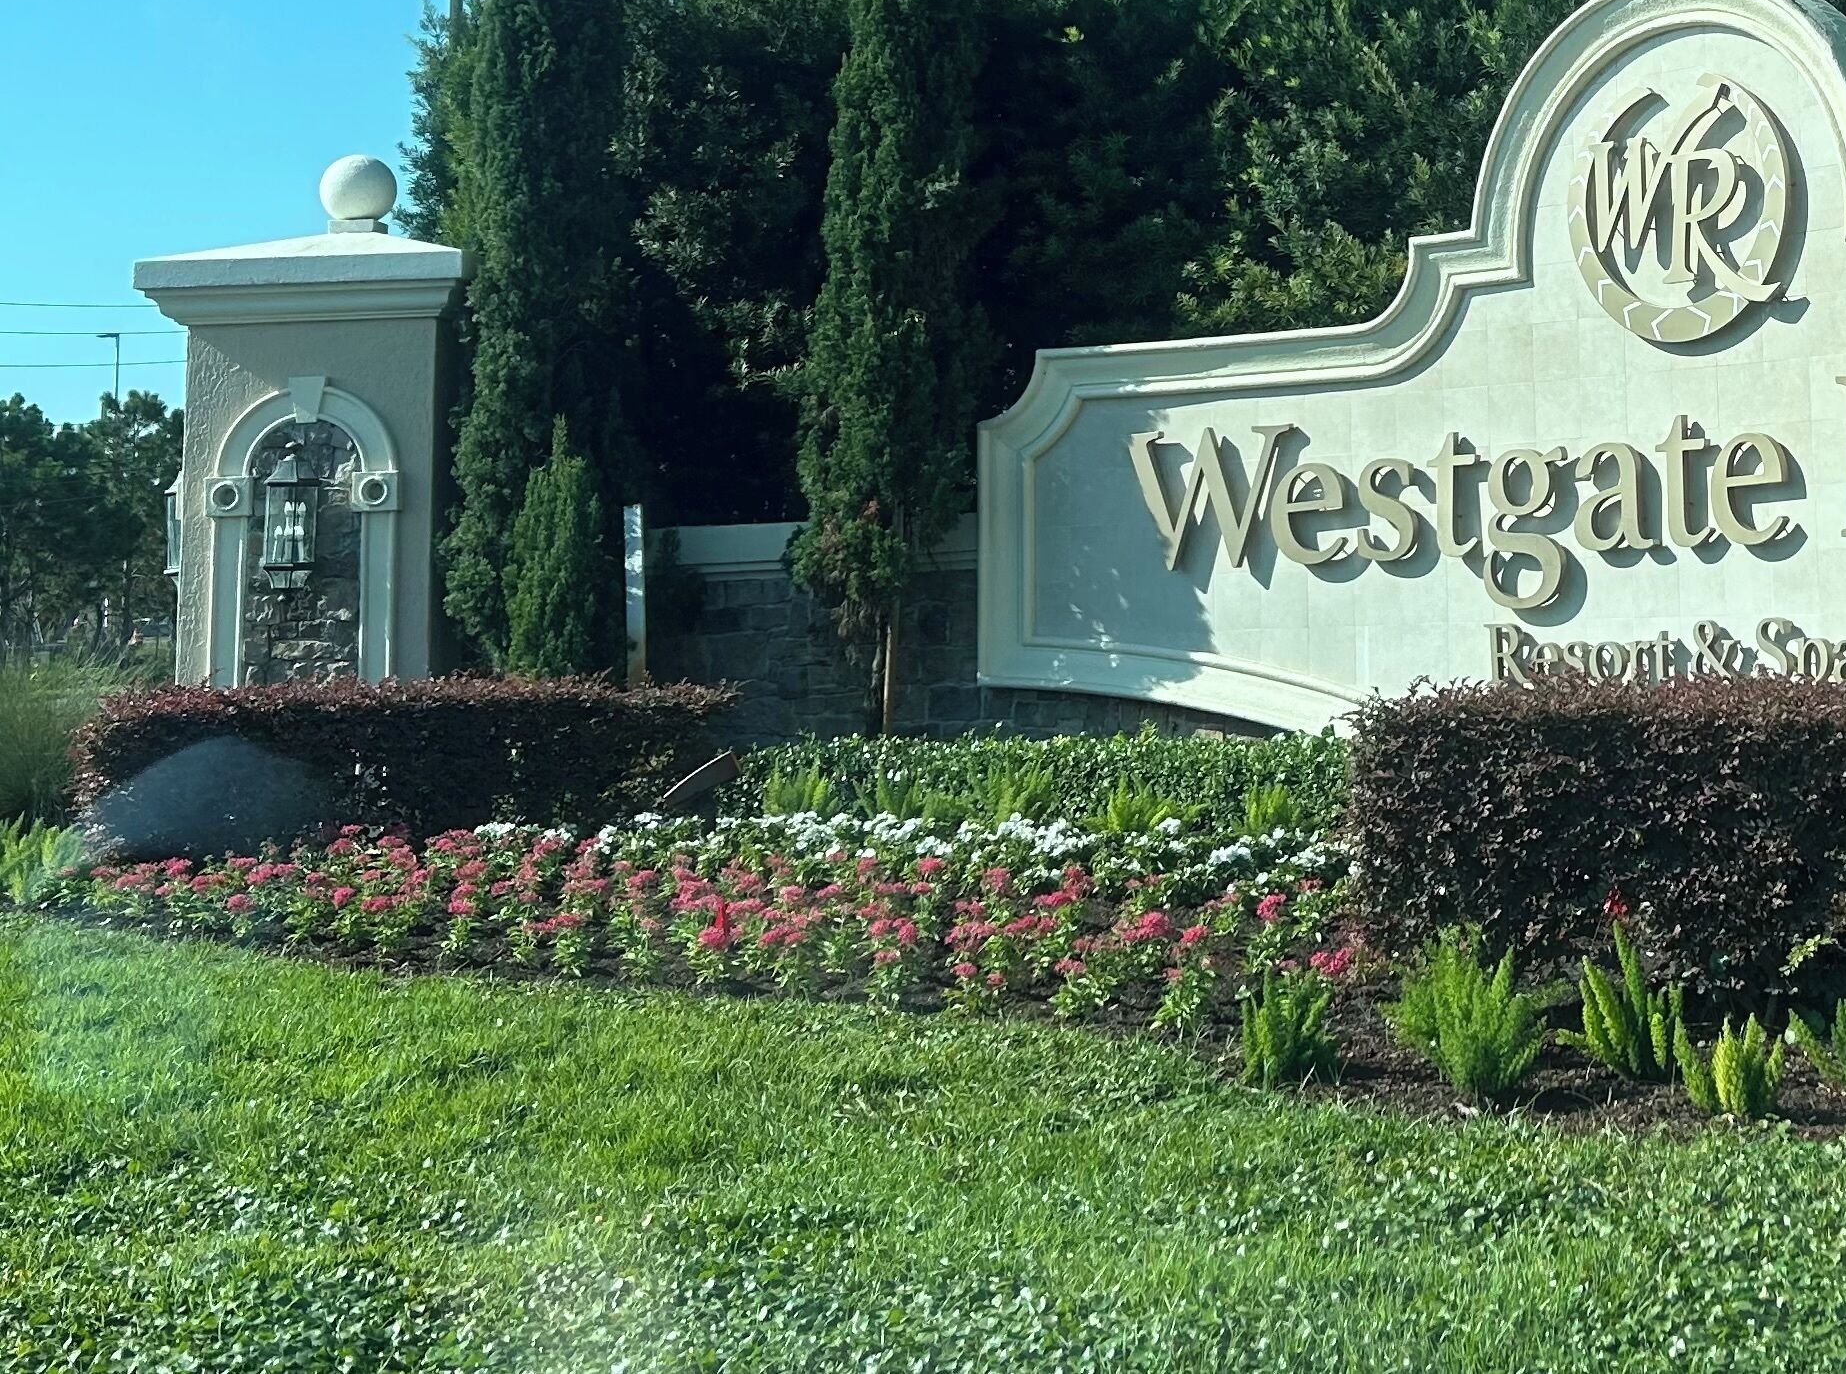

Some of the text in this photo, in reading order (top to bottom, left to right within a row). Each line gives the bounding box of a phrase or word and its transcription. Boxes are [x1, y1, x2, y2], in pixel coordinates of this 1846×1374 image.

[1128, 414, 1791, 610] Westgate
[1484, 622, 1676, 684] Resort
[1691, 619, 1741, 679] &
